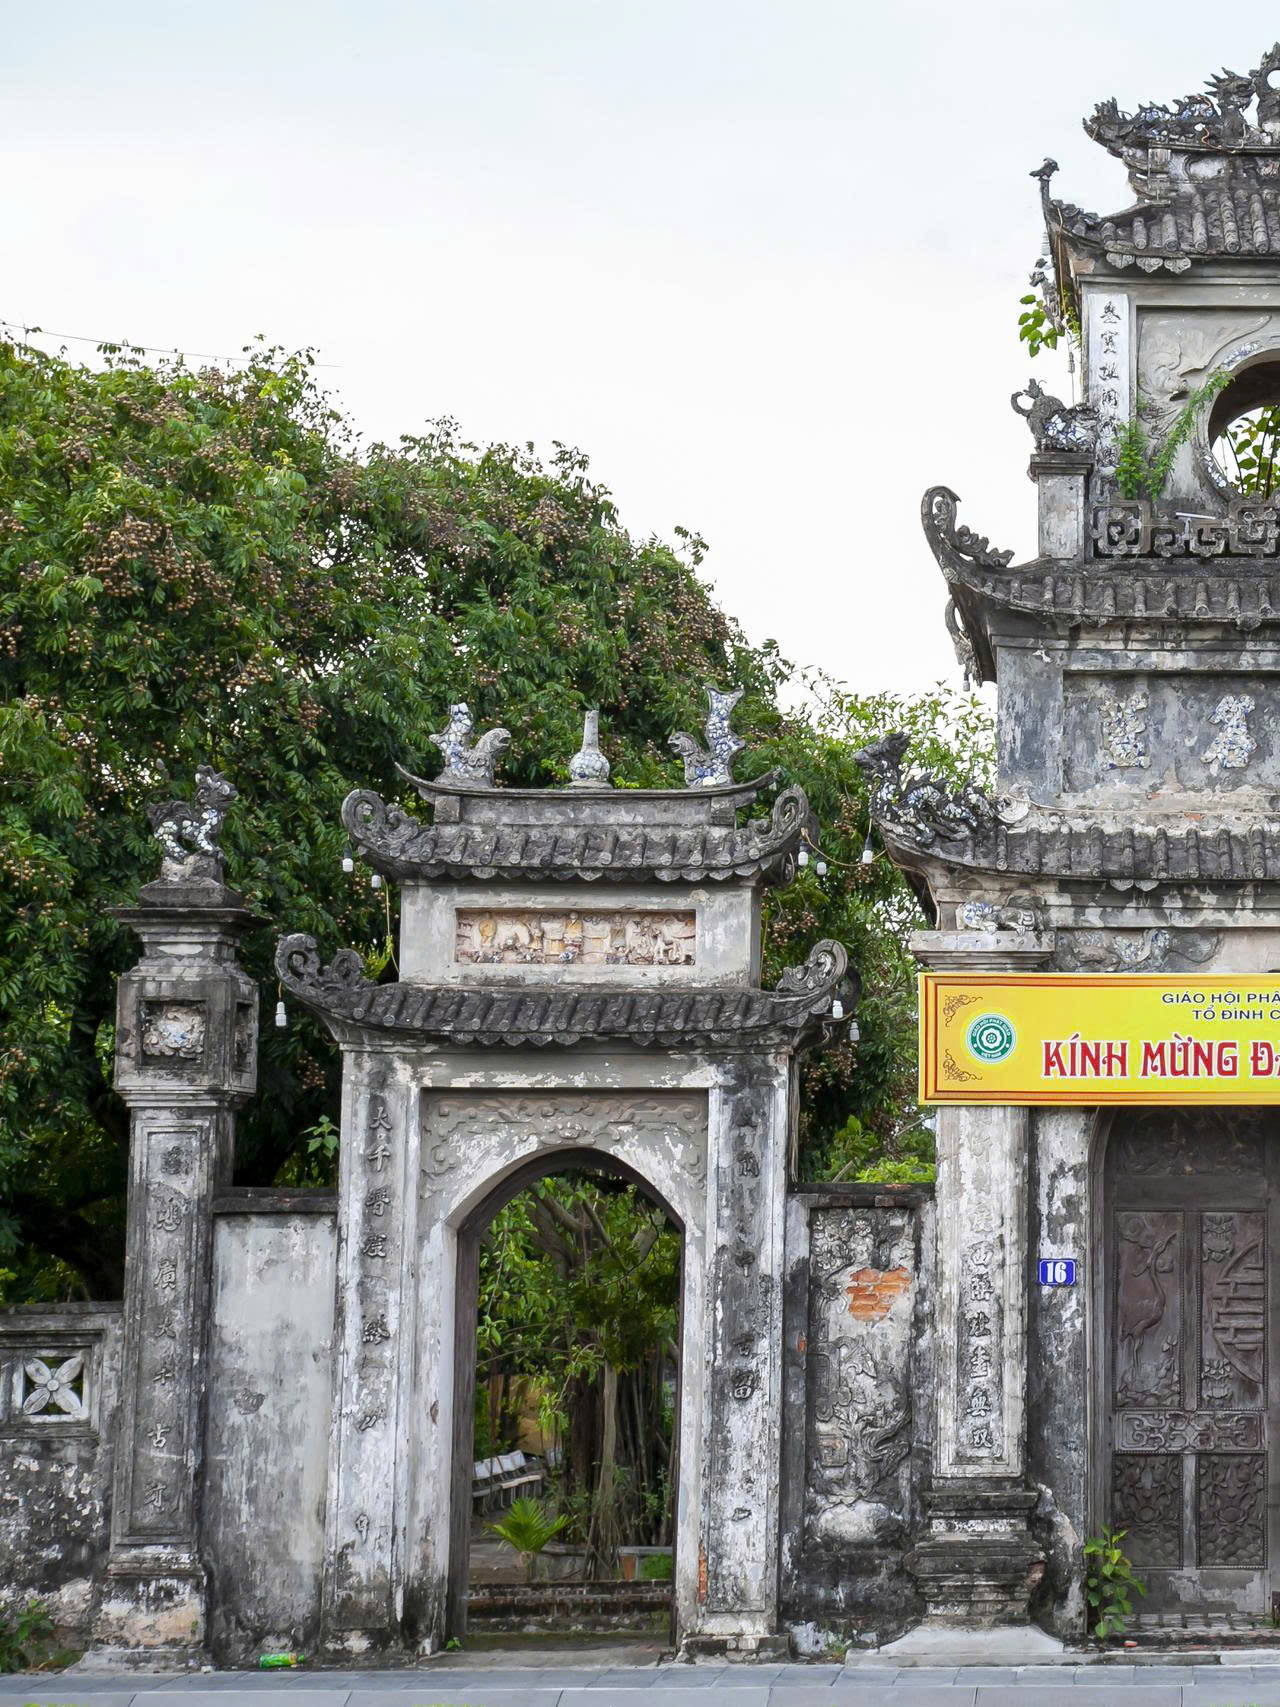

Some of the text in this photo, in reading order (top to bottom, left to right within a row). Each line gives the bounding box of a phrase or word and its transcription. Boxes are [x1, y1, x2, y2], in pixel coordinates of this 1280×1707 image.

[1162, 991, 1206, 1003] GIÁO
[1211, 991, 1240, 1006] HỘI
[1192, 1004, 1216, 1020] TỔ
[1221, 1008, 1263, 1020] ĐÌNH
[1045, 1033, 1127, 1077] KÍNH
[1142, 1034, 1238, 1077] MỪNG
[1046, 1261, 1067, 1283] 16
